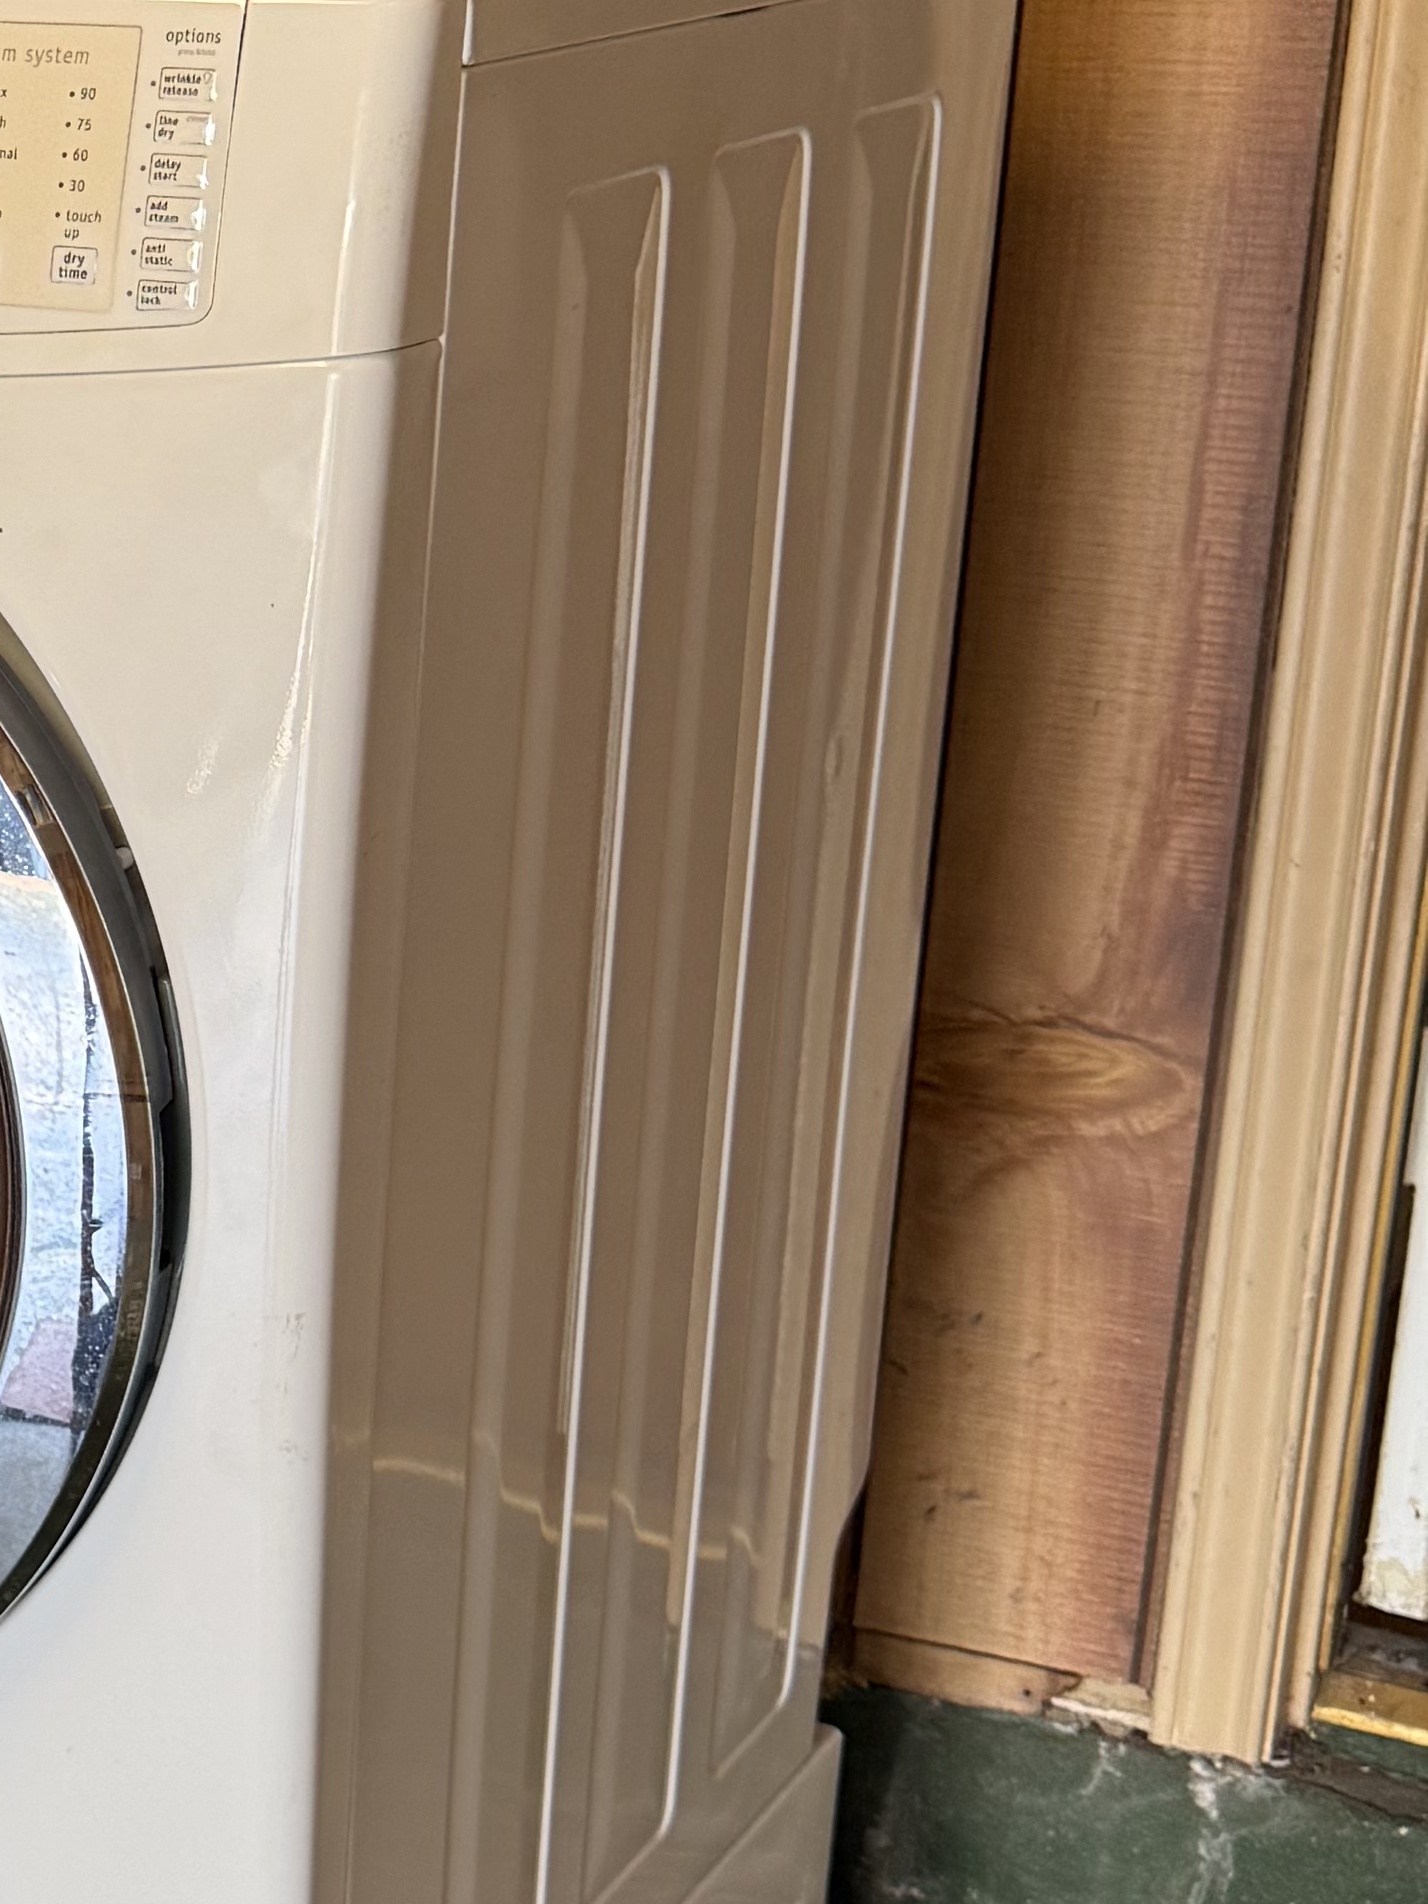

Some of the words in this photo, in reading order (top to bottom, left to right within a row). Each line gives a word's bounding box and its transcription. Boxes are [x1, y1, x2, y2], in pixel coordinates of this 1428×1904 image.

[165, 28, 222, 46] options
[24, 46, 90, 68] system
[164, 73, 202, 85] wrinkle
[80, 87, 97, 101] 90
[163, 85, 199, 97] release
[77, 118, 92, 131] 75
[158, 127, 174, 141] dry
[73, 148, 89, 162] 60
[154, 159, 181, 173] delay
[153, 171, 177, 181] start
[69, 179, 86, 193] 30
[150, 201, 168, 211] add
[66, 210, 102, 223] touch
[149, 213, 179, 224] steam
[64, 228, 80, 241] up
[145, 244, 166, 254] anti
[64, 251, 85, 268] dry
[144, 256, 173, 267] static
[59, 266, 88, 280] time
[141, 283, 177, 295] control
[140, 295, 161, 306] lock
